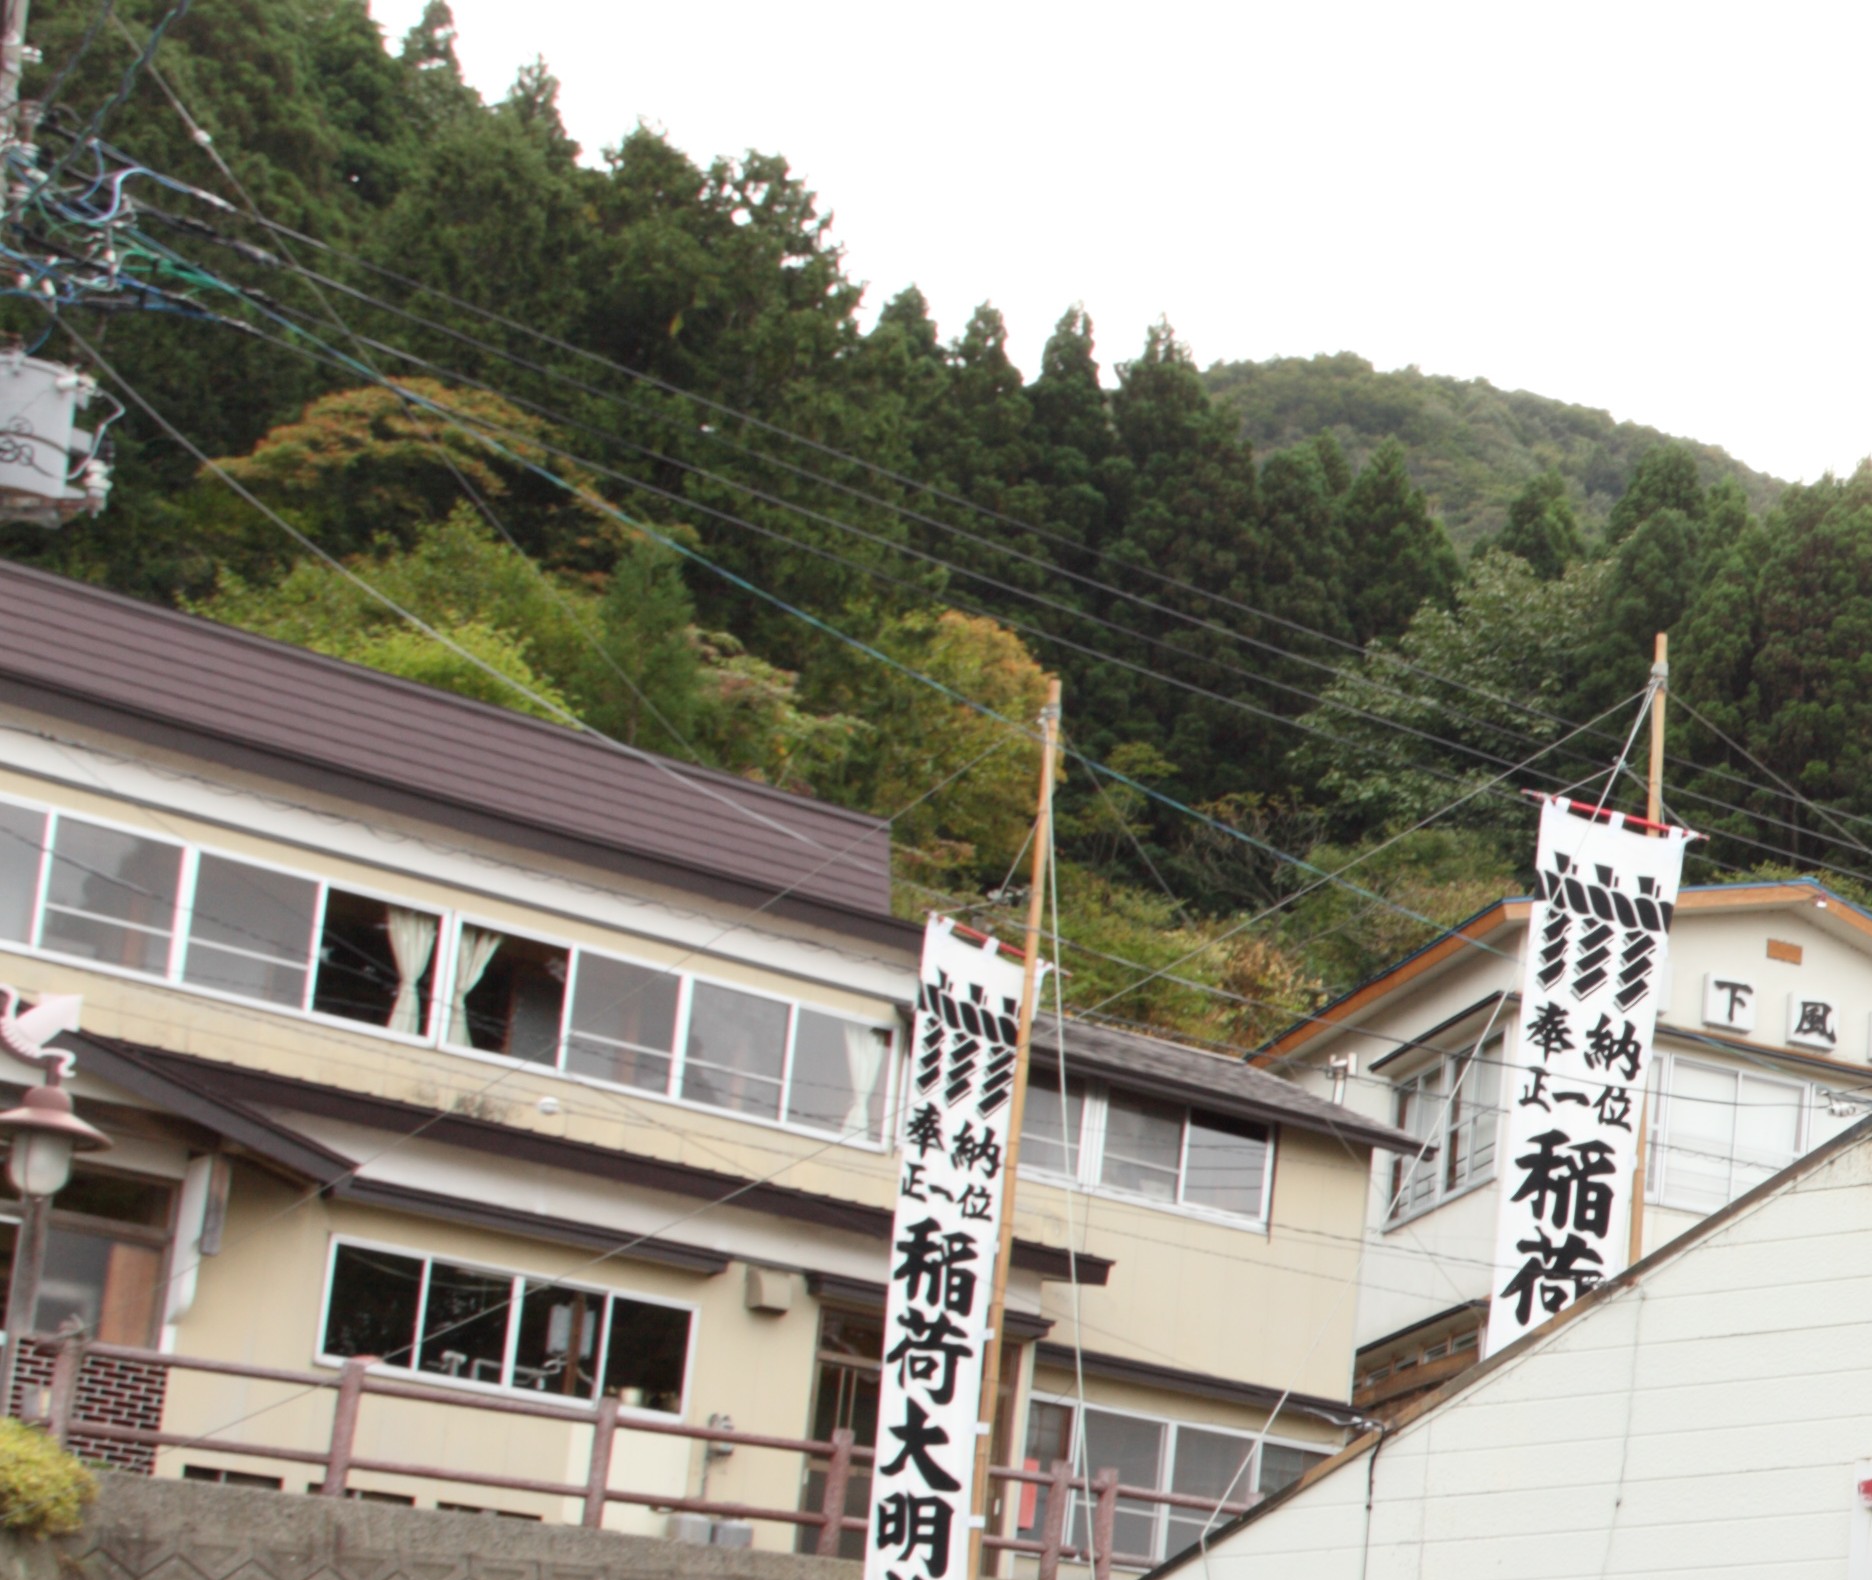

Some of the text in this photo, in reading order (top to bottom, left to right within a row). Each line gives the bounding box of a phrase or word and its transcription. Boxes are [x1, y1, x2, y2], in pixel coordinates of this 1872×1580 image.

[1526, 1001, 1643, 1086] 奉納
[1519, 1062, 1633, 1133] 正一位
[904, 1101, 1003, 1182] 奉納
[900, 1157, 994, 1224] 正一位
[1502, 1129, 1617, 1326] 稲荷
